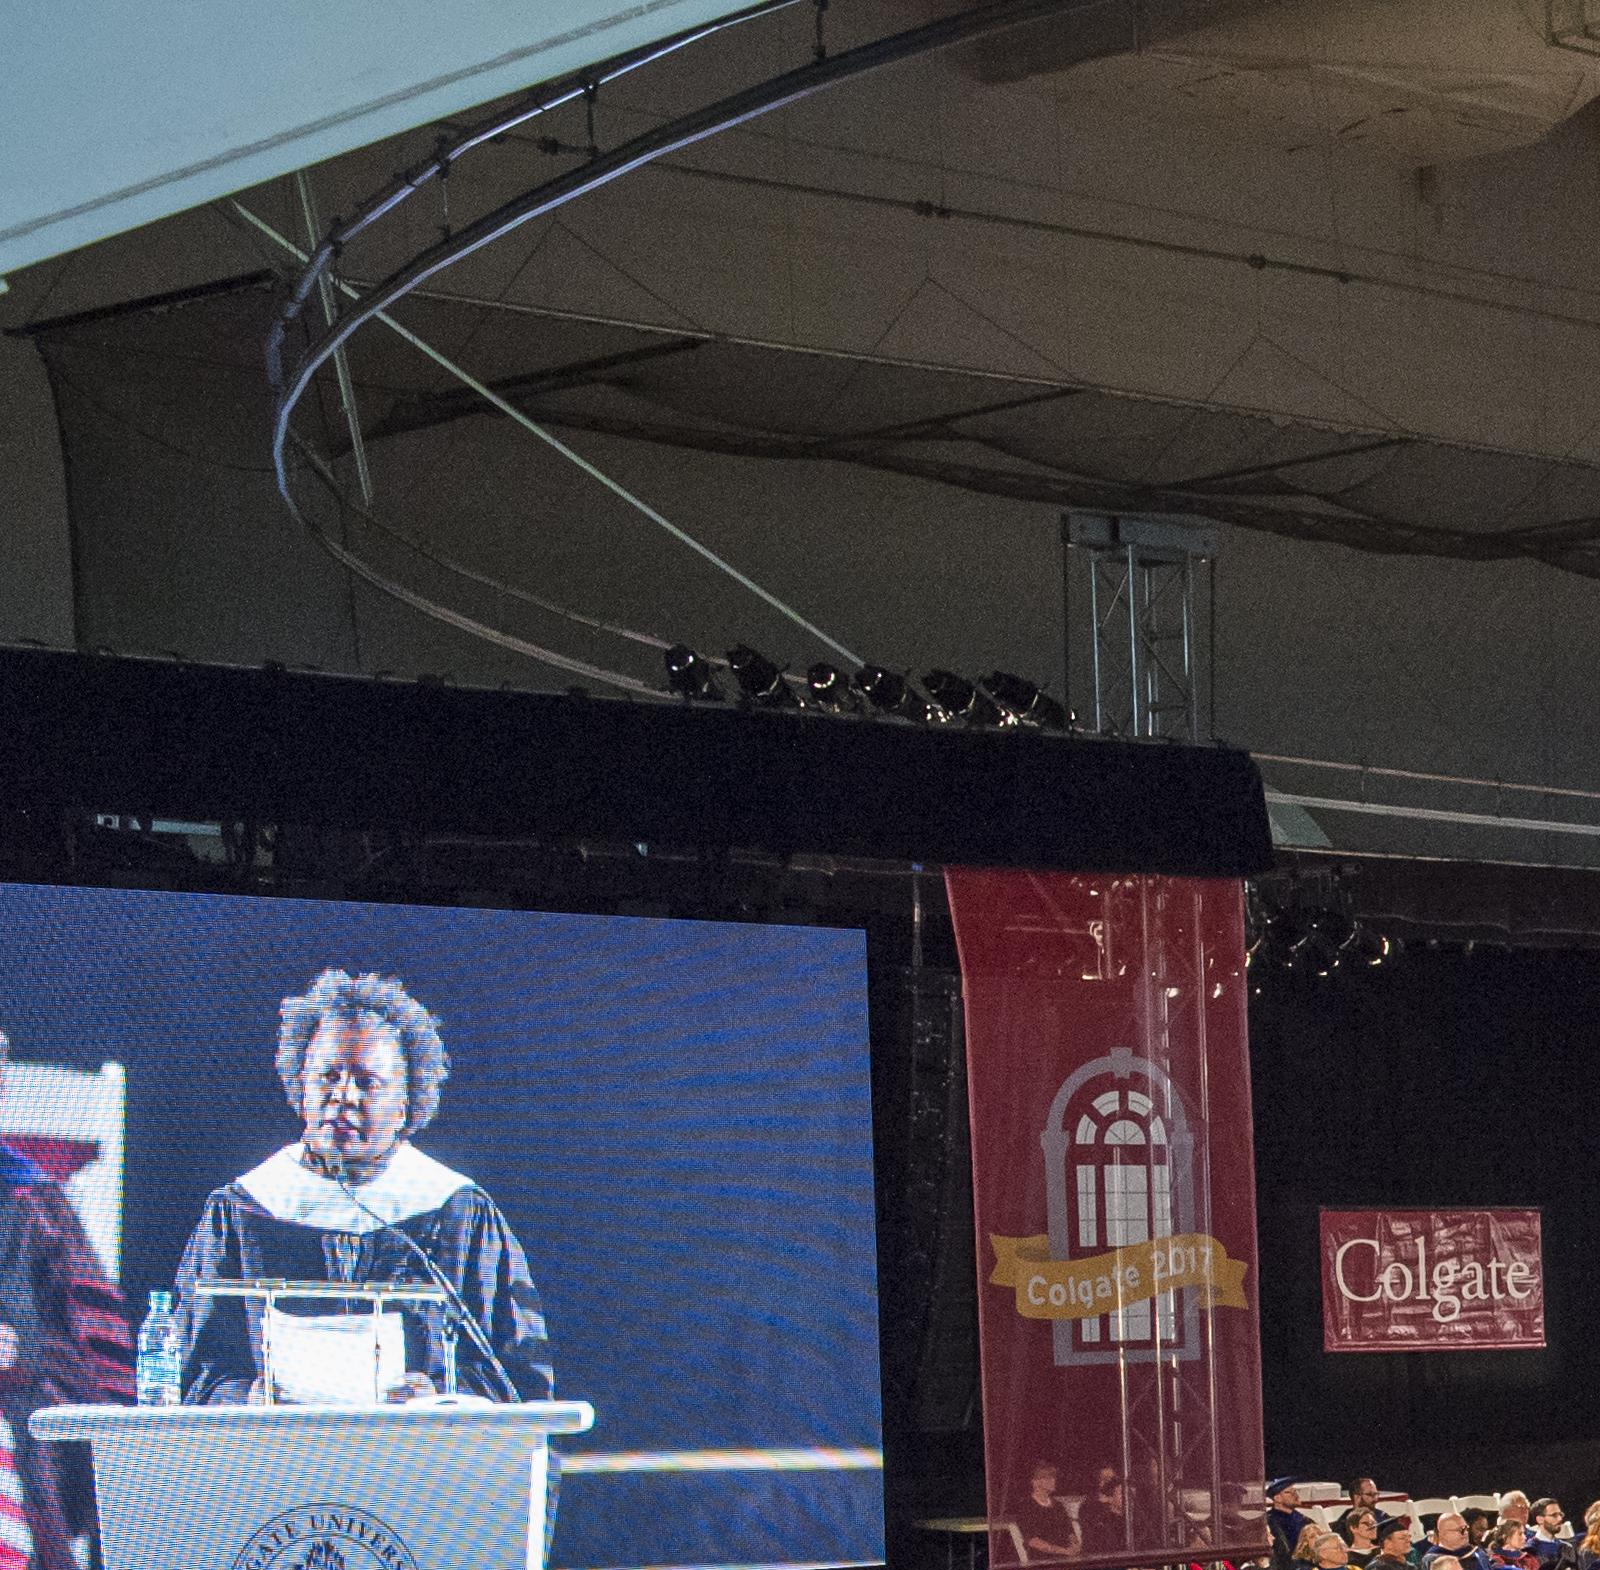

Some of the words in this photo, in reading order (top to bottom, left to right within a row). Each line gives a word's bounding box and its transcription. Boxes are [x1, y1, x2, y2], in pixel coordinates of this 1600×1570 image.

[1027, 1264, 1140, 1309] Colgate
[1151, 1246, 1213, 1280] 2017
[1336, 1236, 1531, 1322] Colgate
